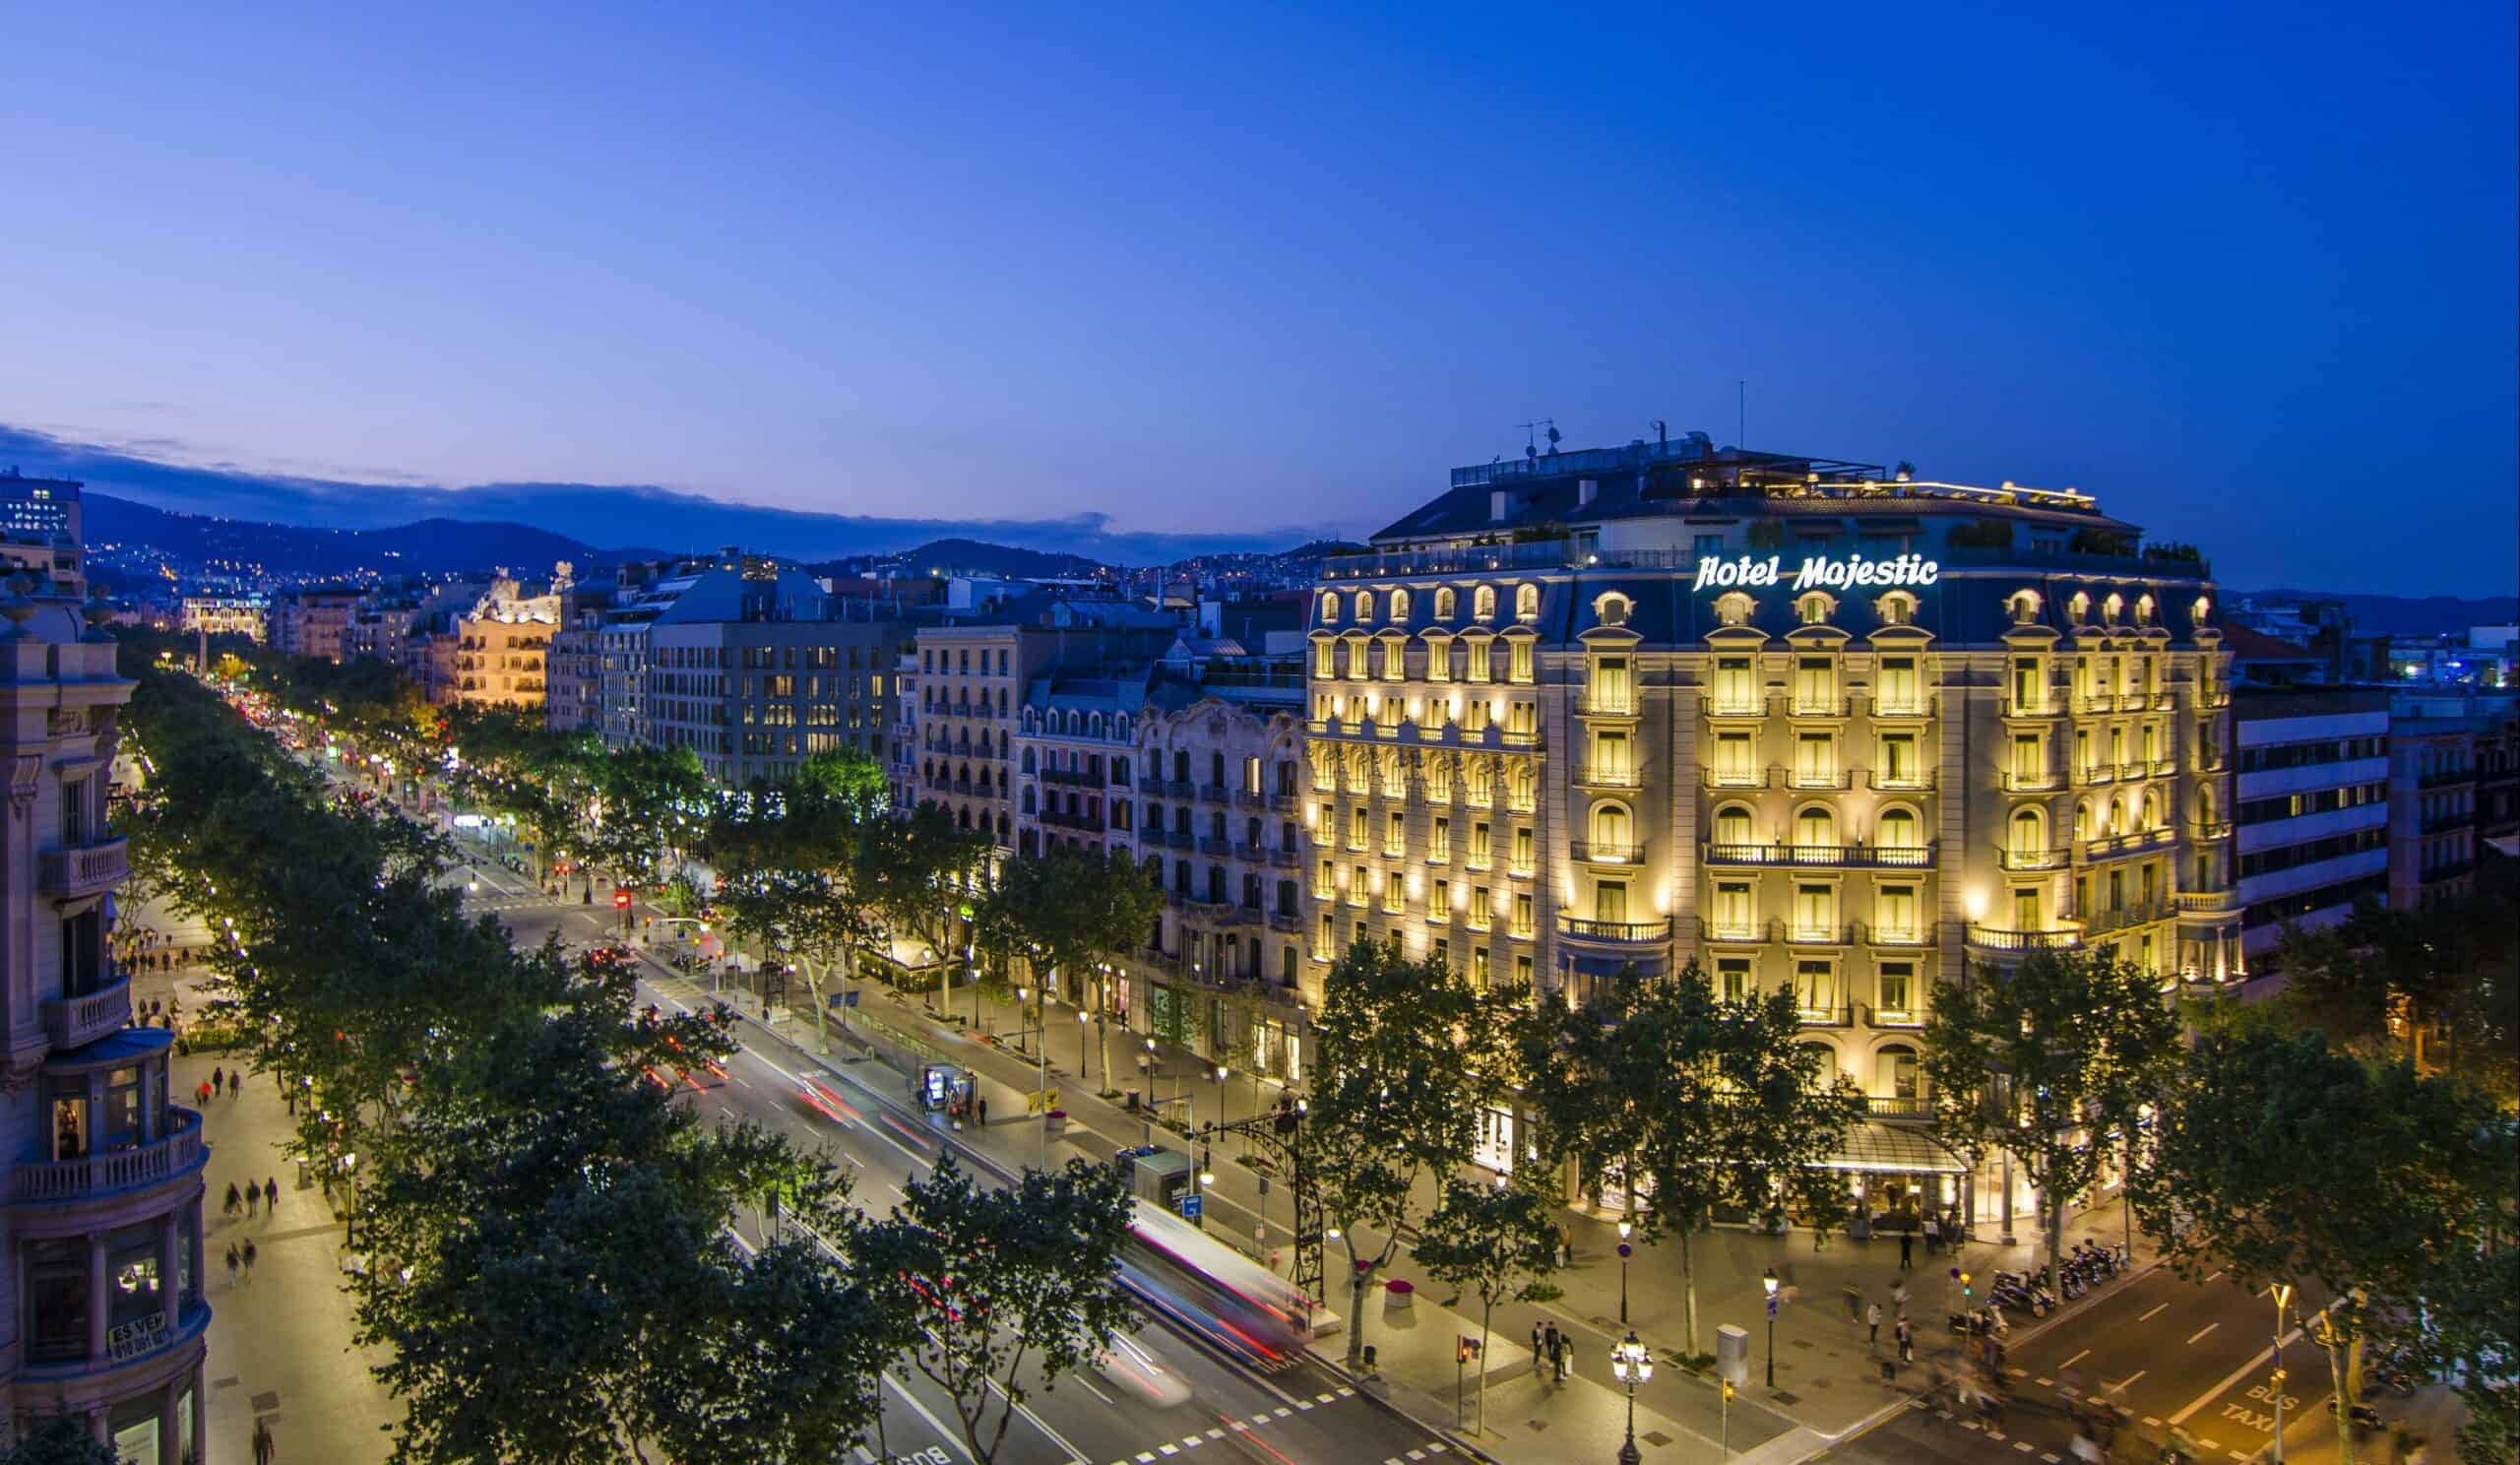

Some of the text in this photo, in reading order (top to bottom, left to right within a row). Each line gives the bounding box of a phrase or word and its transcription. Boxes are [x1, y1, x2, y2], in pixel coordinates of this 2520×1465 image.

[1693, 553, 1938, 592] Hotel Majestic
[2245, 1385, 2300, 1410] BUS
[2221, 1402, 2276, 1432] TAXI
